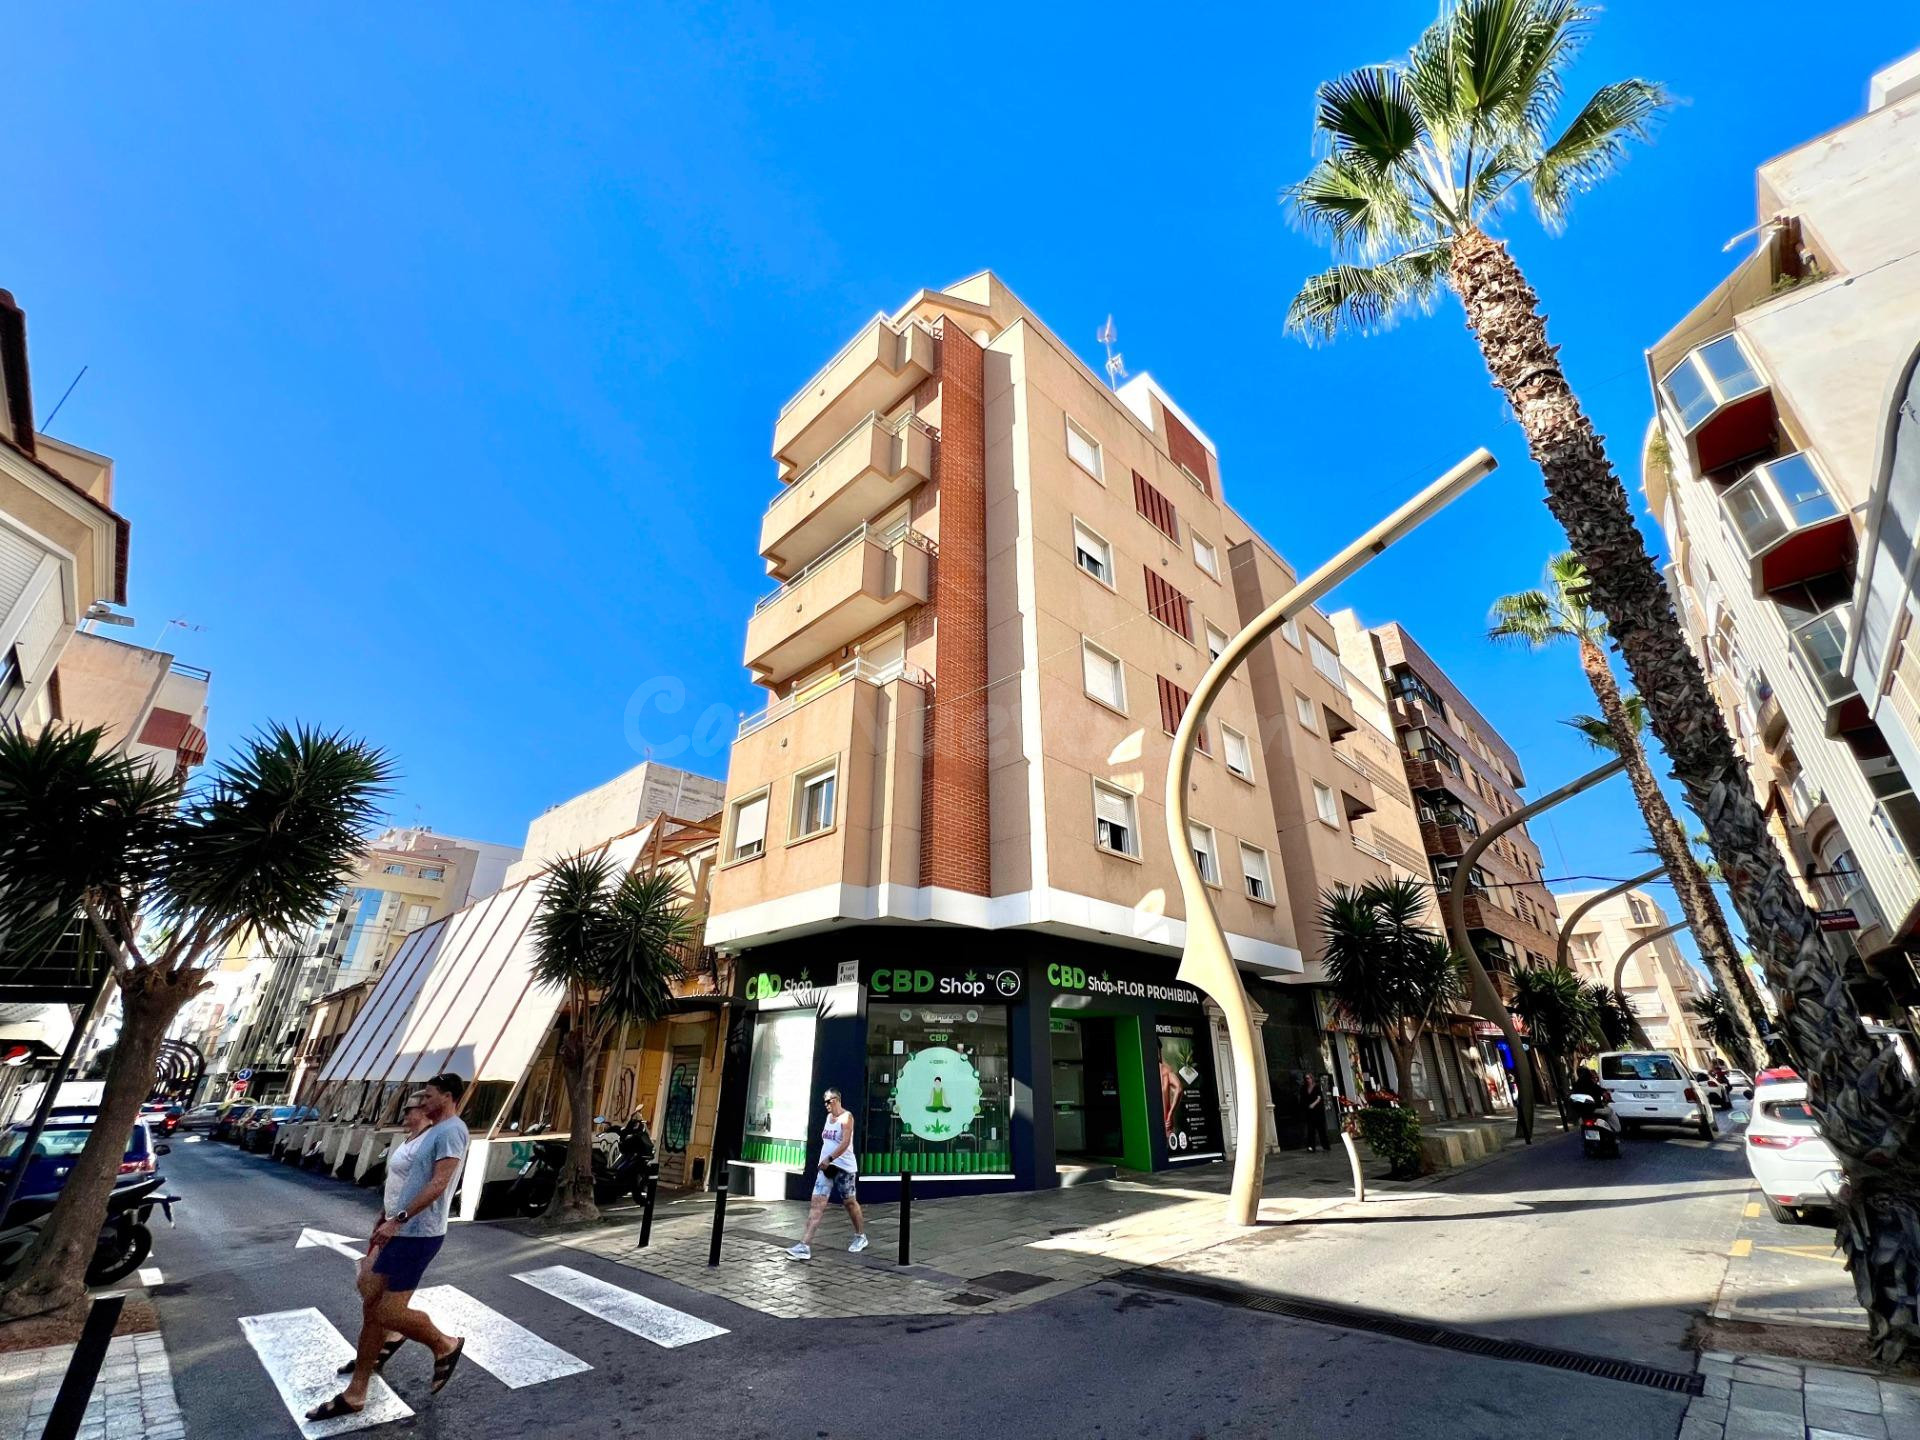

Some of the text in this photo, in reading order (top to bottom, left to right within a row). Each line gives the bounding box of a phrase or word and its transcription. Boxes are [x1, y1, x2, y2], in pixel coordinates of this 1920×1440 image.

[745, 973, 782, 1000] CBD
[784, 978, 813, 996] Shop
[871, 969, 935, 992] CBD
[940, 977, 985, 997] Shop
[1047, 963, 1086, 989] CBD
[1088, 976, 1113, 995] Shop
[1117, 980, 1145, 998] FLOR
[1147, 985, 1199, 1004] PROHIBIDA
[929, 1033, 949, 1042] CBD
